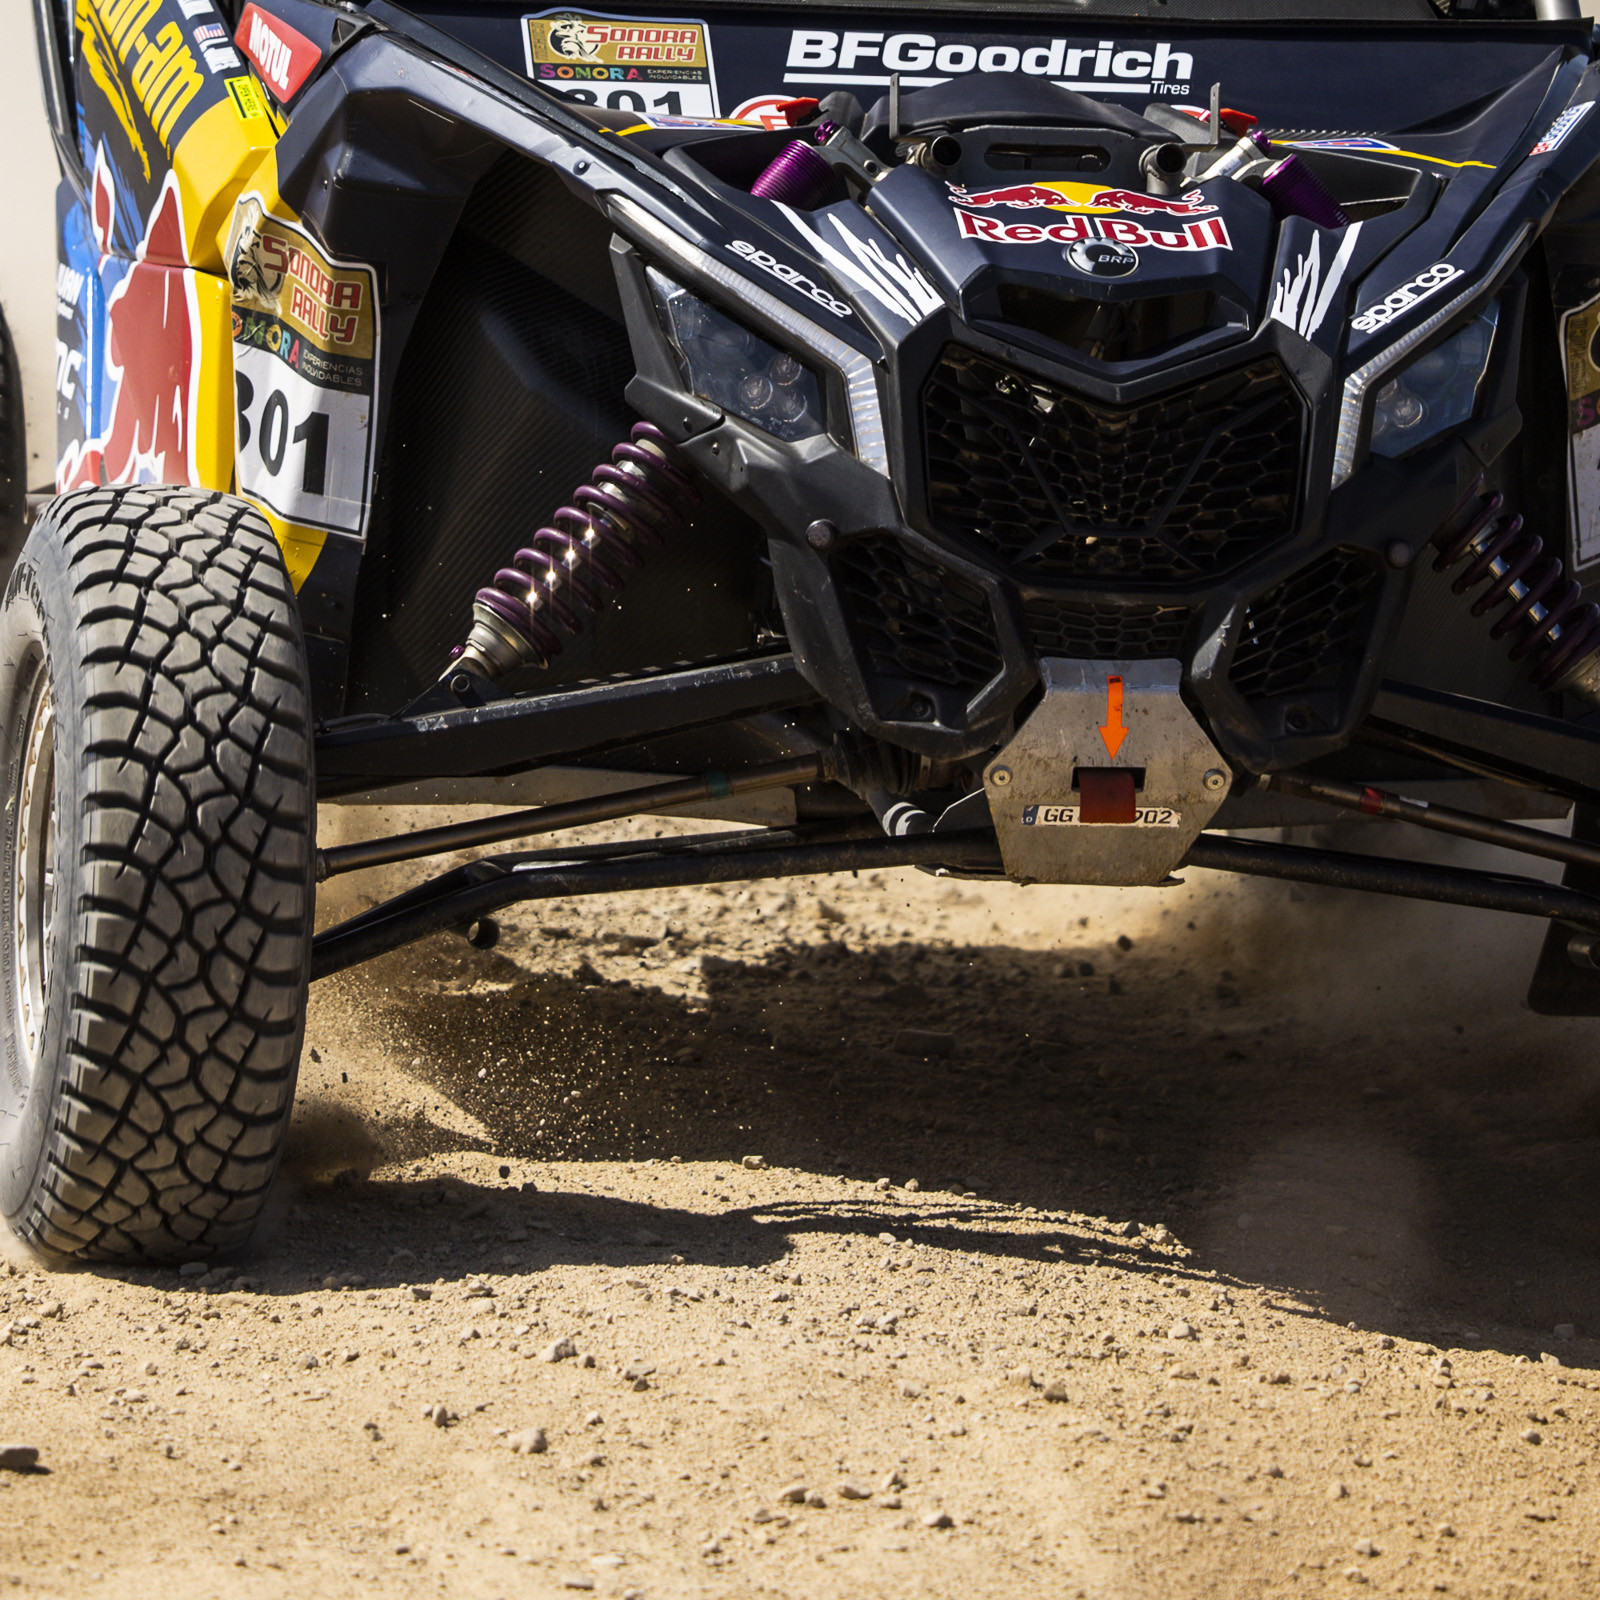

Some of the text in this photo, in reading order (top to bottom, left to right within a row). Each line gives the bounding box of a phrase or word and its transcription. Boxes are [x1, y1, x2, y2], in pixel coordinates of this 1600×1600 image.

[248, 12, 293, 91] MOTUL
[586, 24, 698, 46] SONORA
[616, 45, 696, 62] RALLY
[785, 29, 1194, 80] BFGoodrich
[539, 64, 643, 81] SONORA
[1150, 80, 1191, 95] Tires
[954, 208, 1233, 251] Red Bull
[262, 234, 364, 311] SONORA
[728, 238, 854, 318] sparco
[1098, 254, 1135, 264] BRP
[289, 283, 360, 345] RALLY
[1351, 262, 1457, 332] sparco
[232, 311, 300, 369] ONORA
